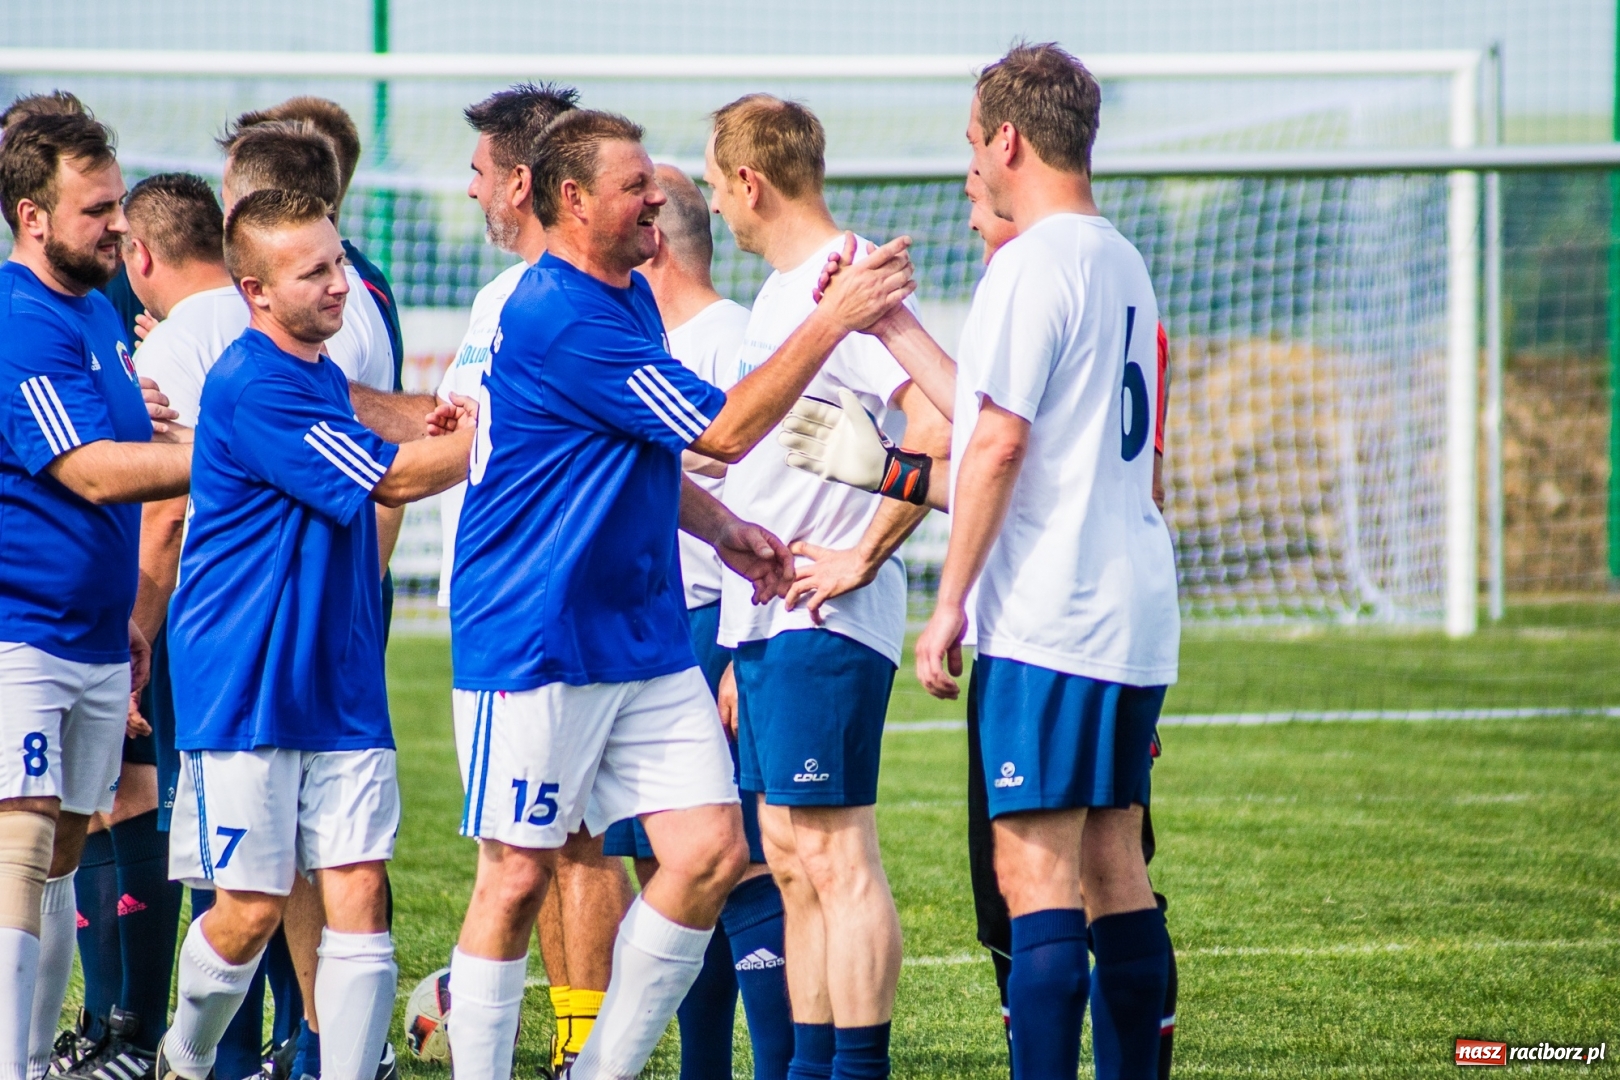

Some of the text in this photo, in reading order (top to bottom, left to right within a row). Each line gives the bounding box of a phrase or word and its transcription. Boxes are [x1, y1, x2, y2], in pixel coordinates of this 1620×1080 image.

[1121, 306, 1150, 462] 6
[23, 731, 49, 777] 8
[512, 778, 560, 826] 15
[214, 825, 248, 869] 7
[735, 957, 785, 971] adidas
